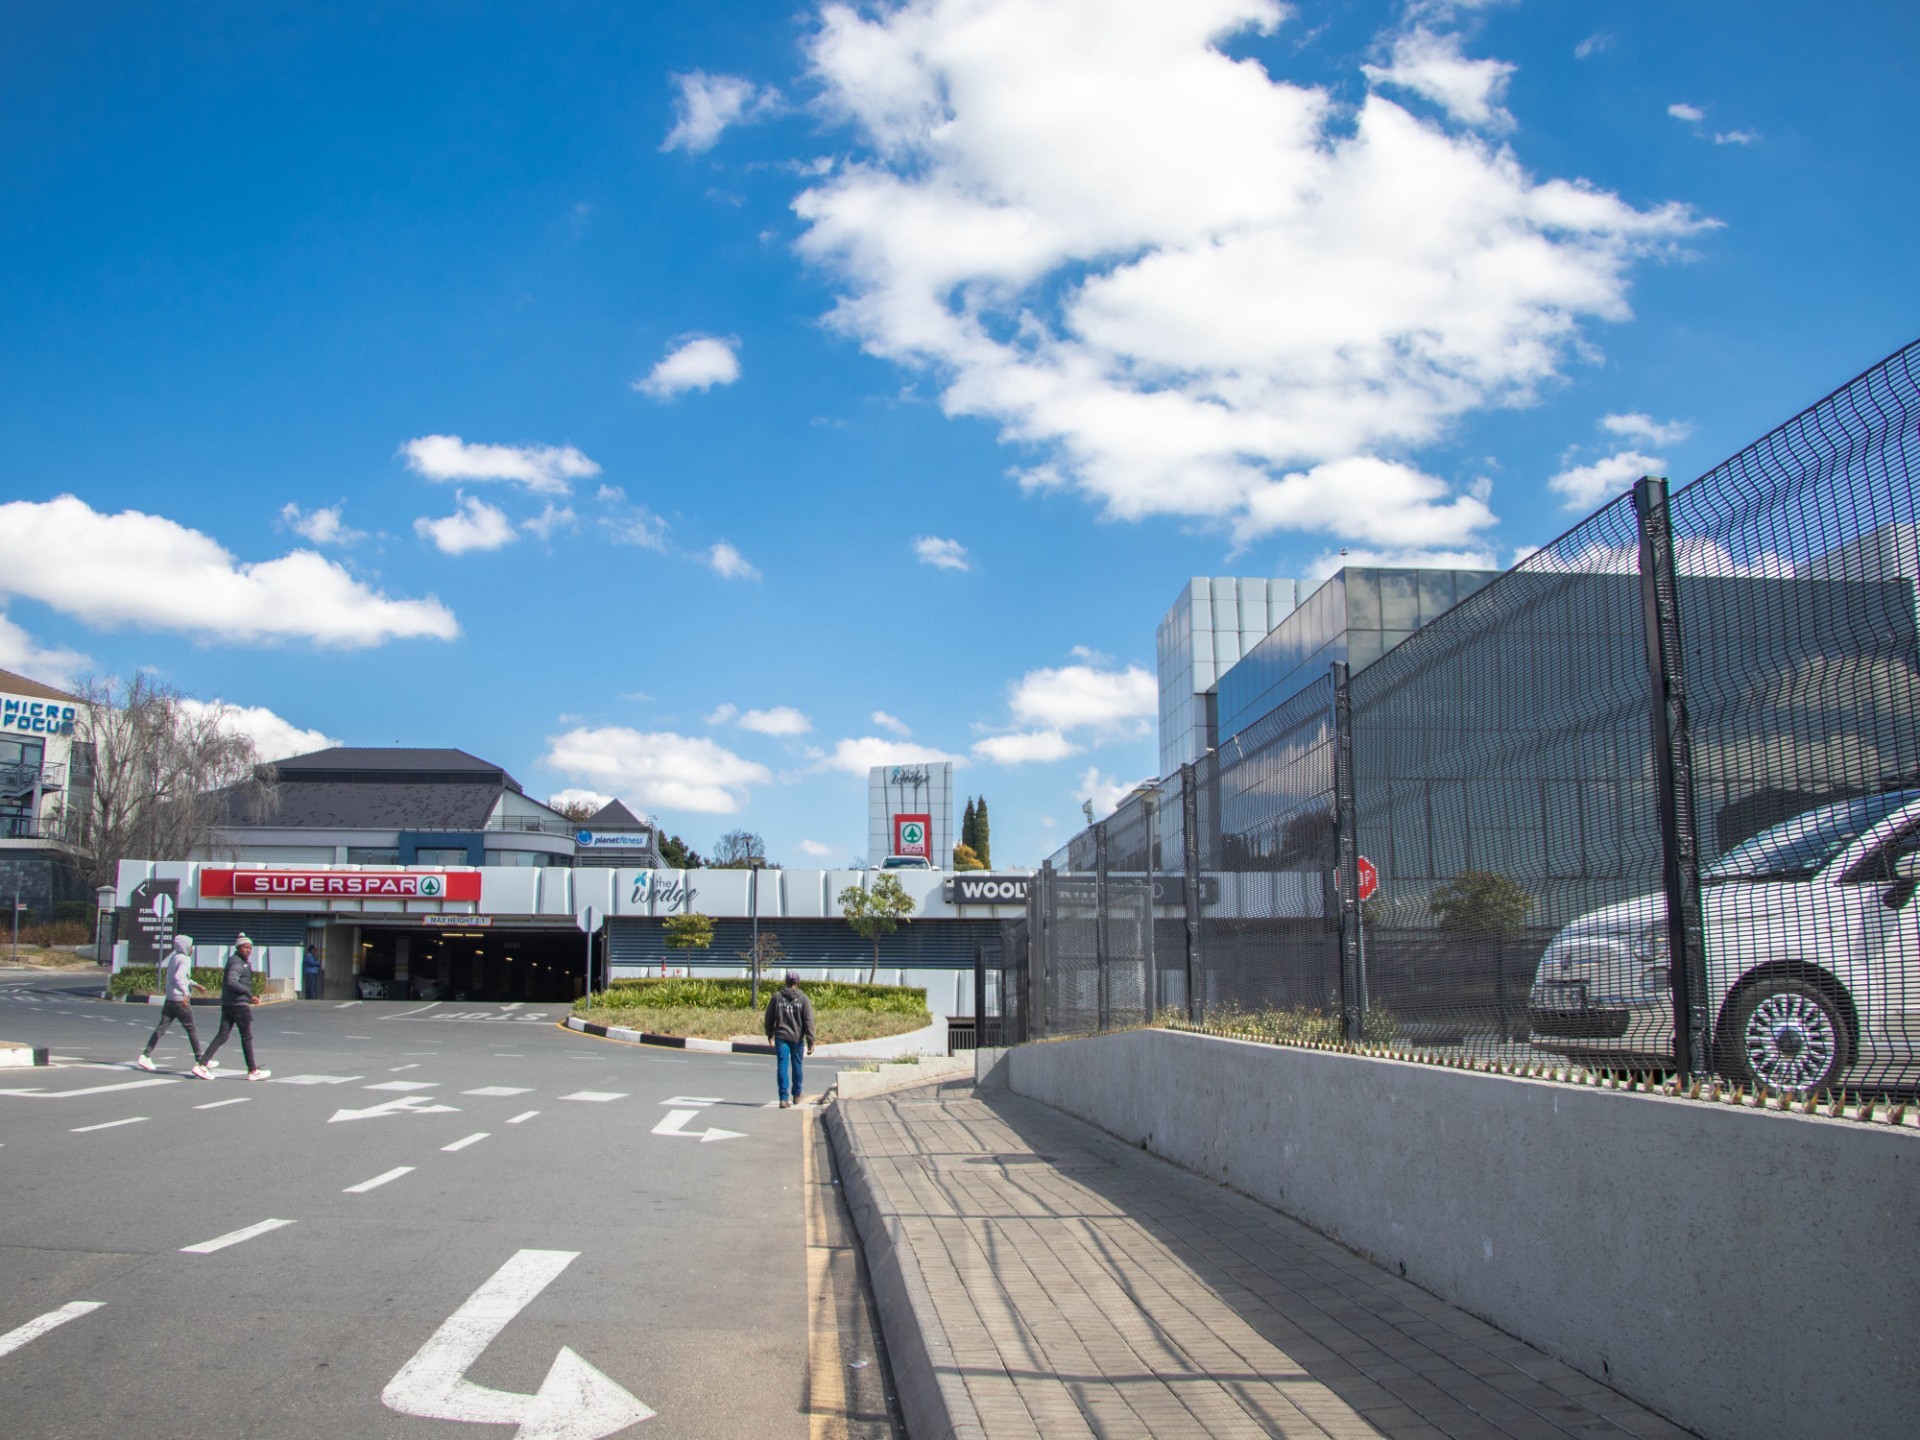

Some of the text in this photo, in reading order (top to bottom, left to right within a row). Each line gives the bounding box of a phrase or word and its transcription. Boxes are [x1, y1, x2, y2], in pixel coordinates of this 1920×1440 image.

[5, 699, 75, 720] MICRO
[4, 713, 74, 735] FOCUS
[254, 877, 416, 893] SUPERSPAR
[656, 876, 673, 888] the
[631, 879, 699, 912] Wedge
[430, 916, 446, 924] MAX
[447, 916, 474, 925] HEIGHT
